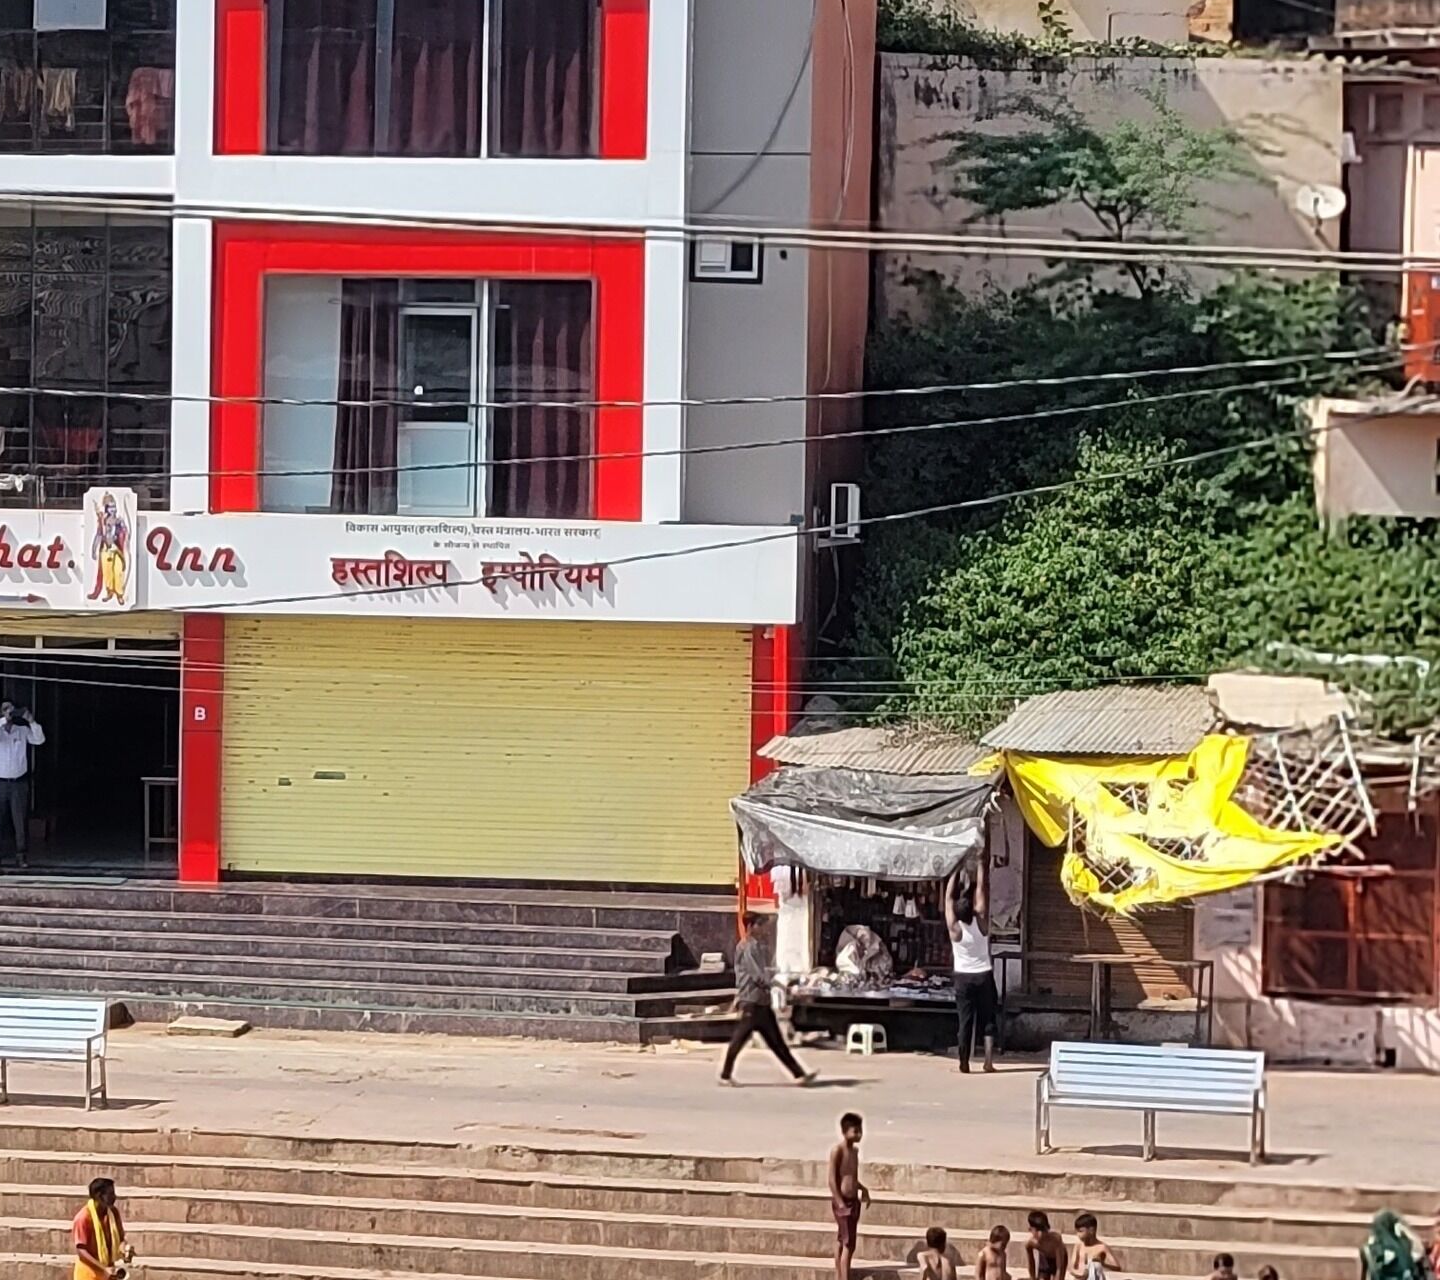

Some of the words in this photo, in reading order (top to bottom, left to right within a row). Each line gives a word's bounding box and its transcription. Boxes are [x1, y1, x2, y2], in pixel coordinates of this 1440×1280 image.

[345, 520, 378, 533] विकास
[146, 526, 237, 572] Inn
[330, 549, 451, 588] हस्तशिल्प
[480, 551, 609, 594] इम्पोरियम
[195, 706, 206, 721] B
